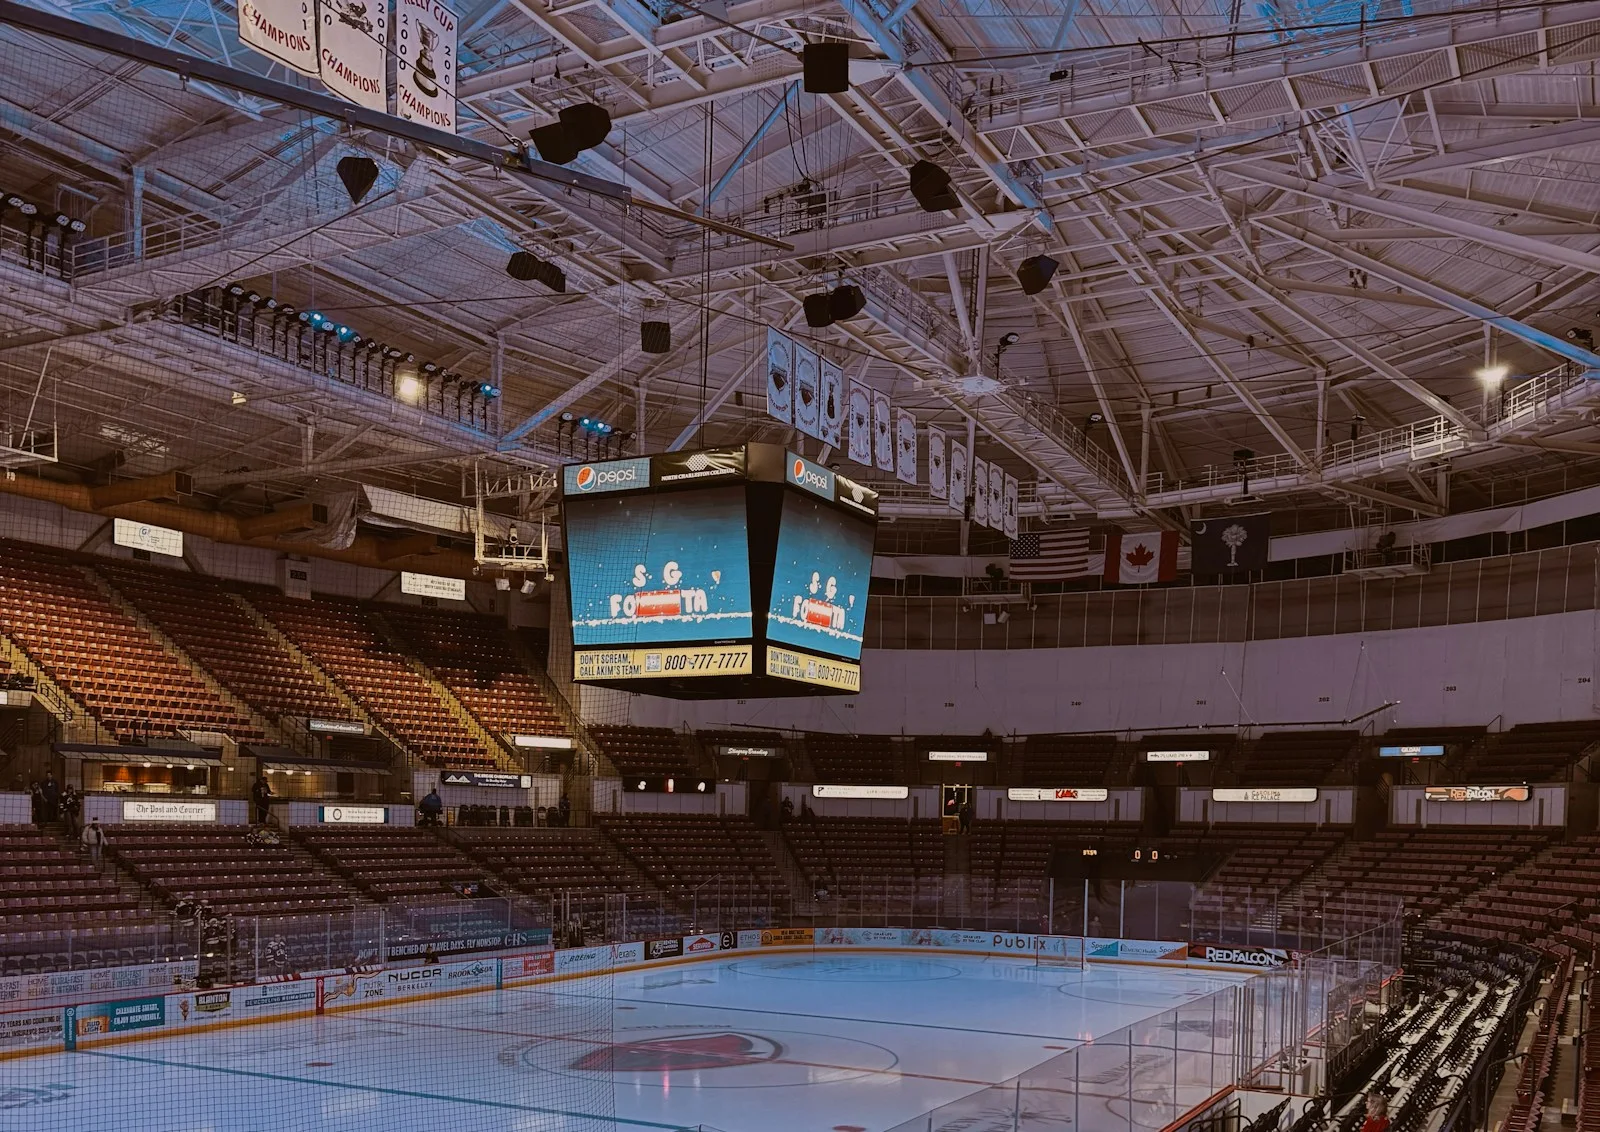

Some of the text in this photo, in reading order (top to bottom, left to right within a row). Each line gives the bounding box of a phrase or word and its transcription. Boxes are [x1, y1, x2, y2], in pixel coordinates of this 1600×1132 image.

[434, 6, 454, 32] CUP
[243, 4, 310, 51] CHAMPIONS
[322, 48, 381, 94] CHAMPIONS
[399, 84, 451, 126] CHAMPIONS
[597, 466, 635, 486] pepsi
[678, 471, 710, 479] CHARLESTON
[710, 468, 736, 476] COLISEUM
[805, 471, 828, 490] pepsi
[580, 653, 631, 665] DON'T SCREAM,
[770, 650, 782, 662] DON'T
[580, 665, 642, 676] CALL AKIM'S TEAM!
[770, 663, 779, 674] CALL
[780, 665, 794, 676] AKIM'S
[136, 804, 204, 814] The Post and Courier
[1134, 849, 1141, 860] 0
[1151, 850, 1158, 860] 0
[504, 932, 528, 947] CHS
[740, 933, 760, 941] ETHOS
[993, 934, 1046, 950] Publix
[391, 943, 419, 956] BENCHED
[429, 941, 450, 952] TRAVEL
[450, 939, 465, 951] DAYS.
[466, 938, 476, 949] FLY
[476, 937, 501, 948] NONSTOP.
[609, 945, 636, 960] Nexans
[569, 953, 596, 962] BOEING
[388, 968, 442, 982] NUCOR
[397, 982, 433, 992] BERKELEY
[198, 992, 228, 1004] BLANTON
[364, 989, 384, 998] ZONE
[7, 1019, 21, 1027] YEARS
[114, 1016, 129, 1025] ENJOY
[84, 1025, 102, 1034] LIGHT
